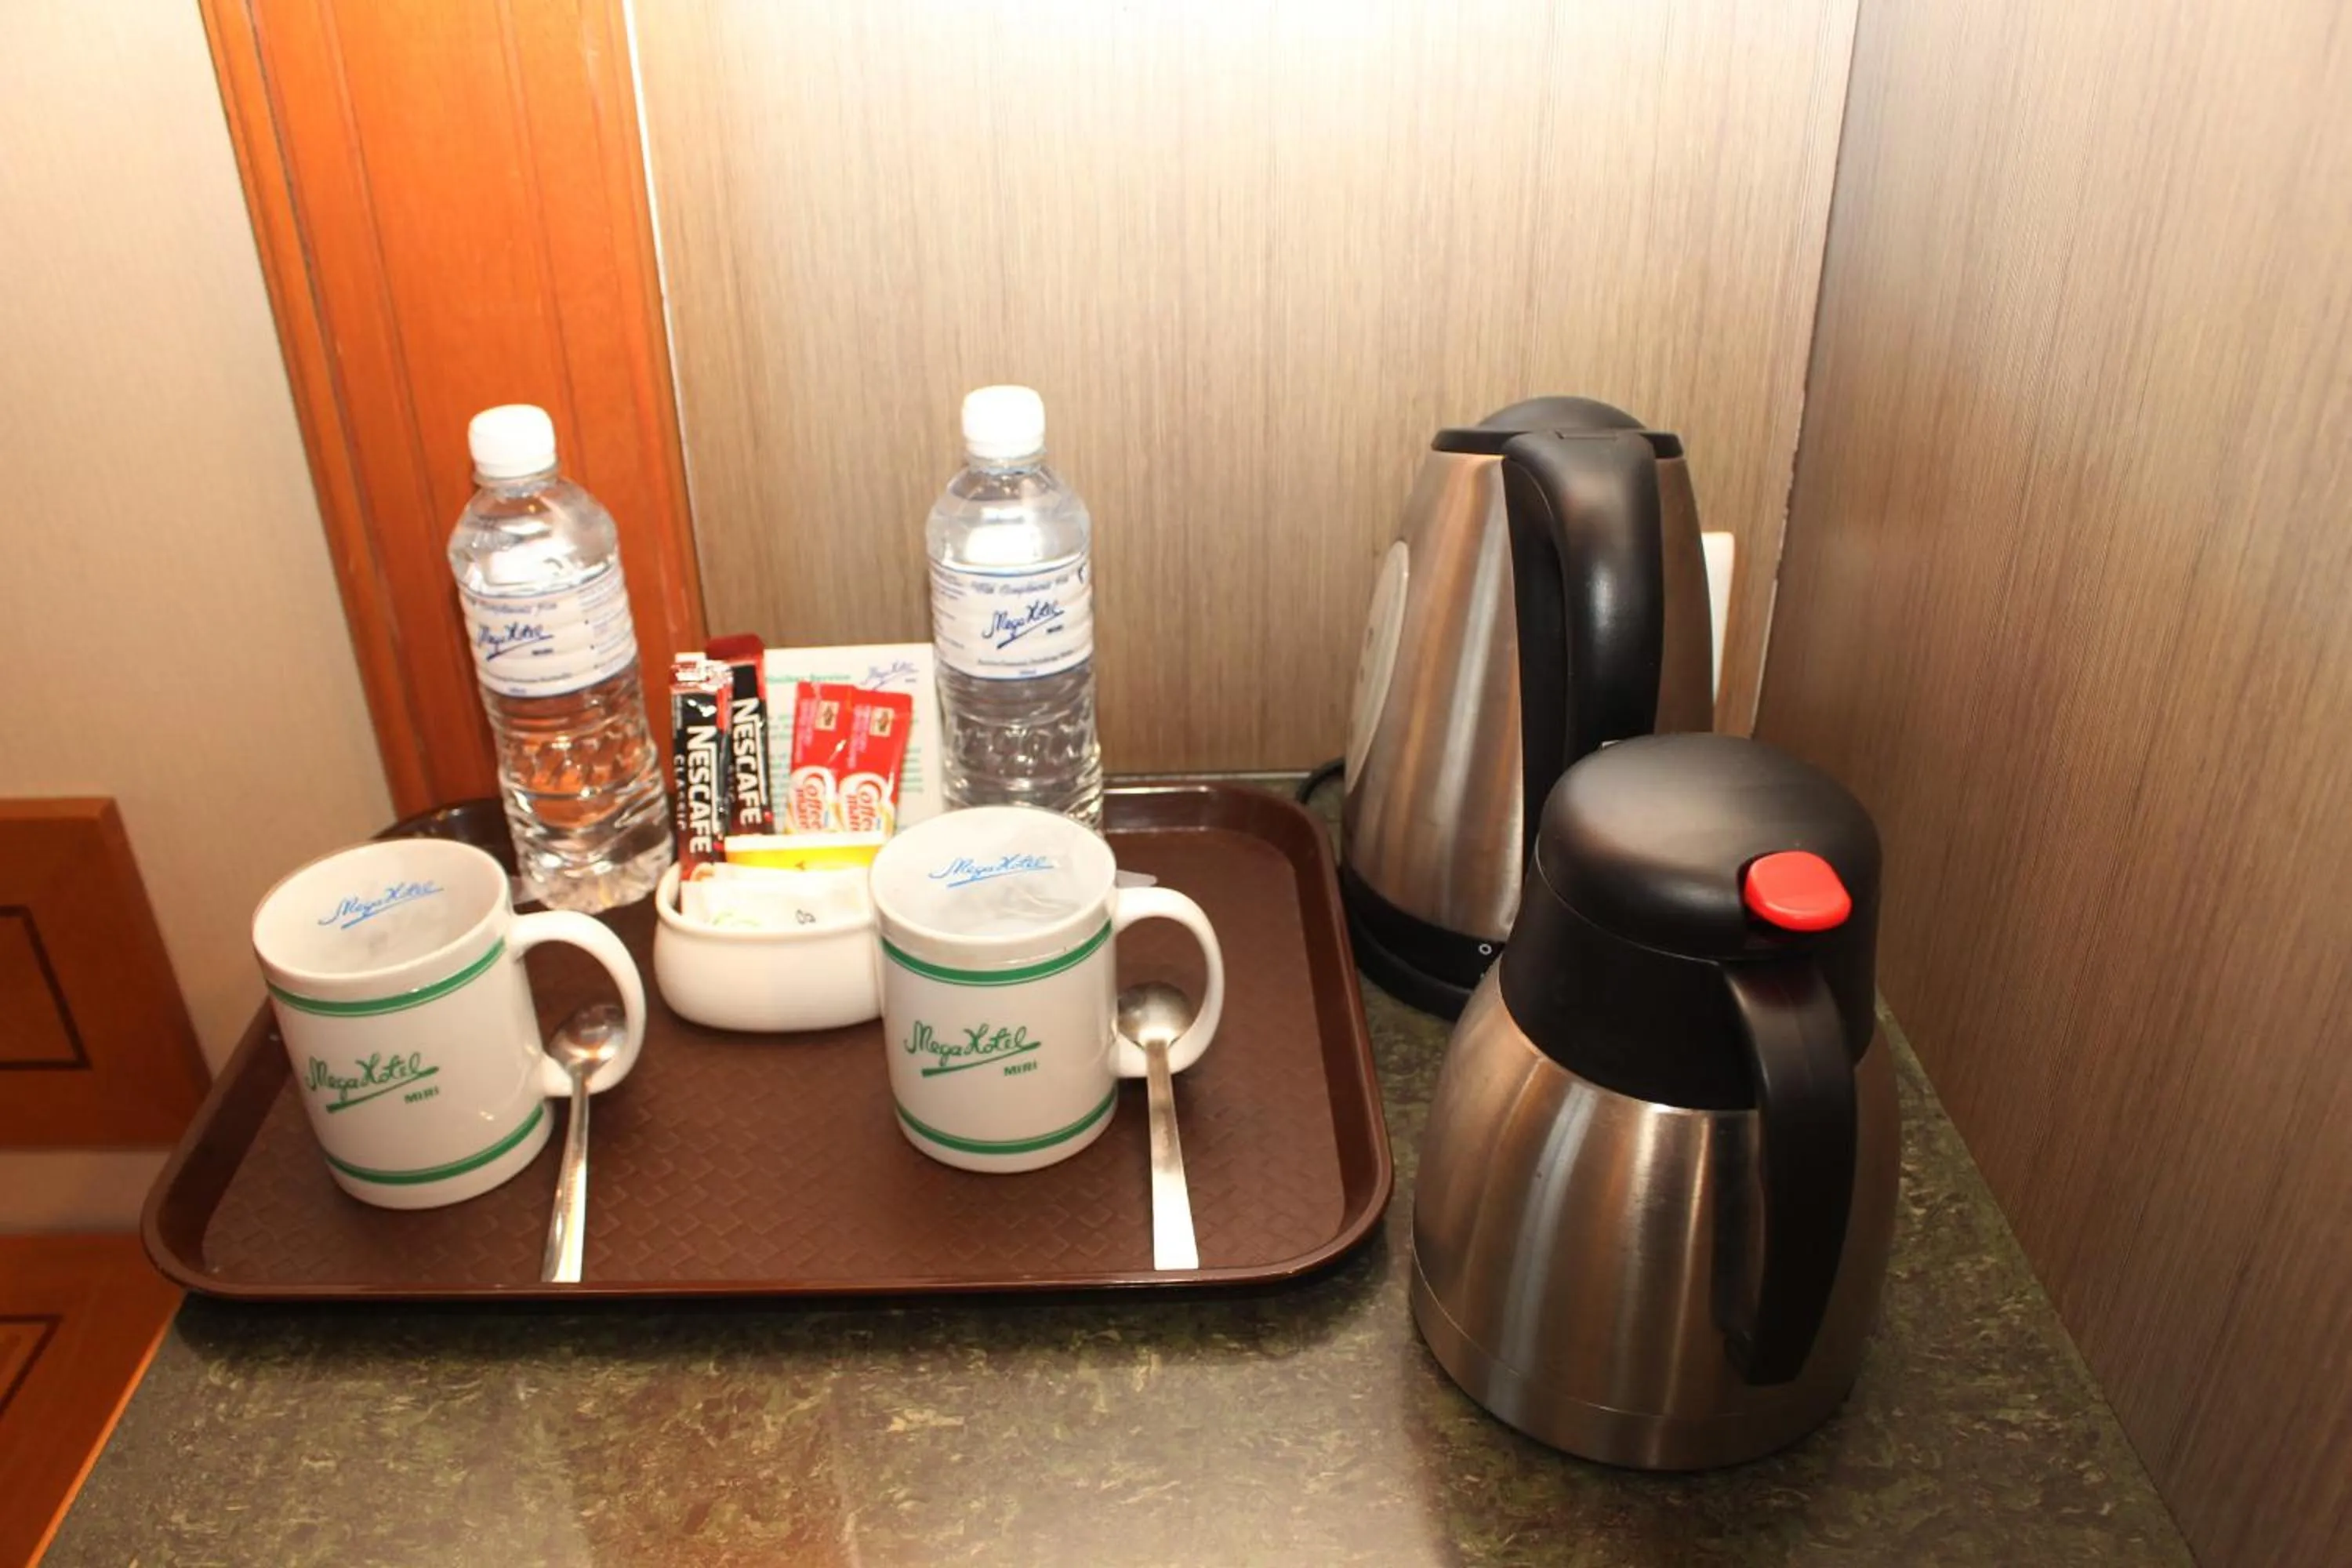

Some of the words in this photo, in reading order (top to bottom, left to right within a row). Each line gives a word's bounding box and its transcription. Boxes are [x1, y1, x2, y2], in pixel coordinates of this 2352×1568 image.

[673, 753, 687, 832] CLASSIC
[903, 1020, 964, 1067] Mega
[964, 1022, 1029, 1055] Hotel
[304, 1055, 359, 1102] Mega
[355, 1051, 425, 1087] Hotel
[1004, 1060, 1038, 1077] MIRI
[404, 1085, 439, 1105] MIRI
